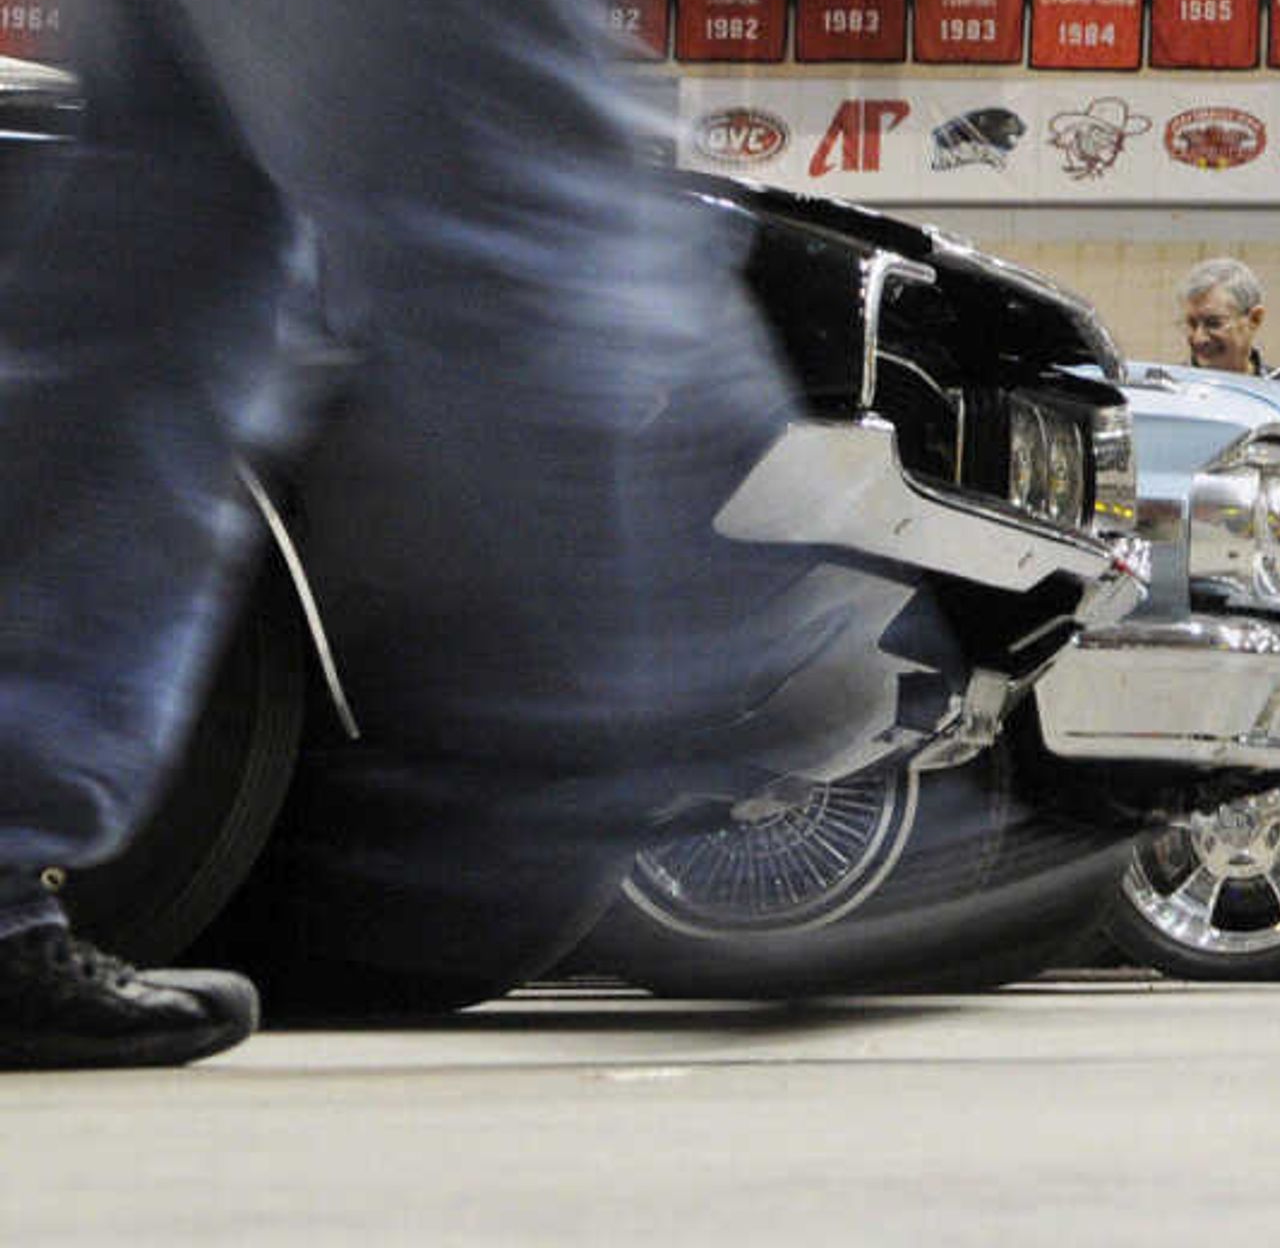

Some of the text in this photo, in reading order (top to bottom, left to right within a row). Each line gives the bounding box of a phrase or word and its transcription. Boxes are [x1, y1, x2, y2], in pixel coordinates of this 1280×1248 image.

[609, 8, 640, 30] 82
[825, 8, 879, 33] 1983
[1180, 0, 1233, 21] 1985
[705, 18, 760, 40] 1982
[940, 19, 996, 41] 1983
[1059, 21, 1116, 46] 1984
